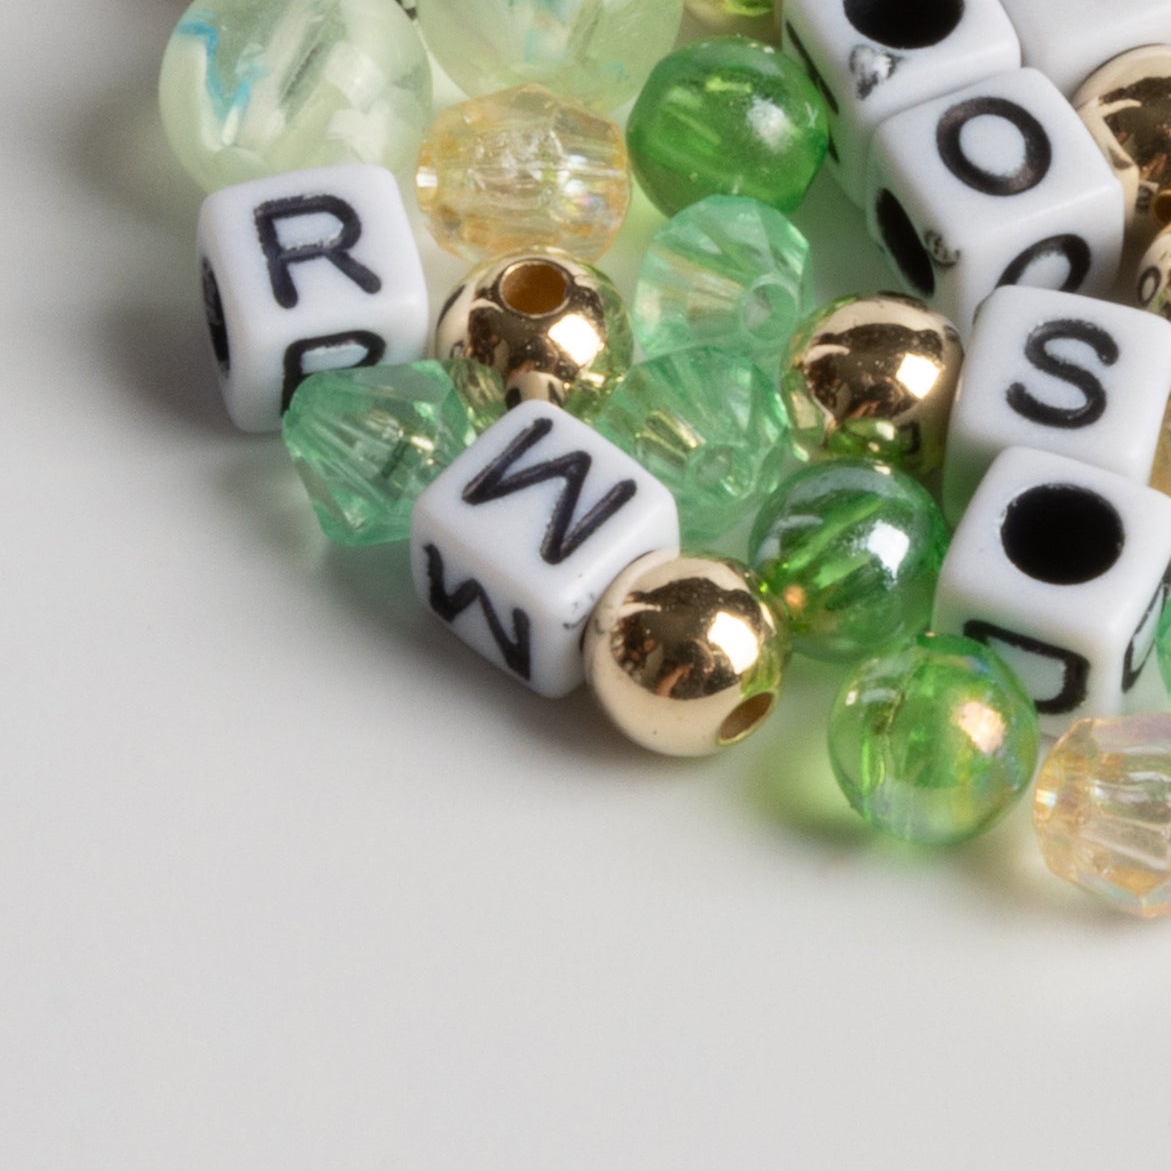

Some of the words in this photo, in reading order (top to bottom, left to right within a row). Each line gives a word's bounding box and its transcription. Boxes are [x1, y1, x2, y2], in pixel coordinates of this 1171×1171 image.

[935, 96, 1053, 197] O
[253, 194, 382, 310] R
[1006, 319, 1119, 430] S
